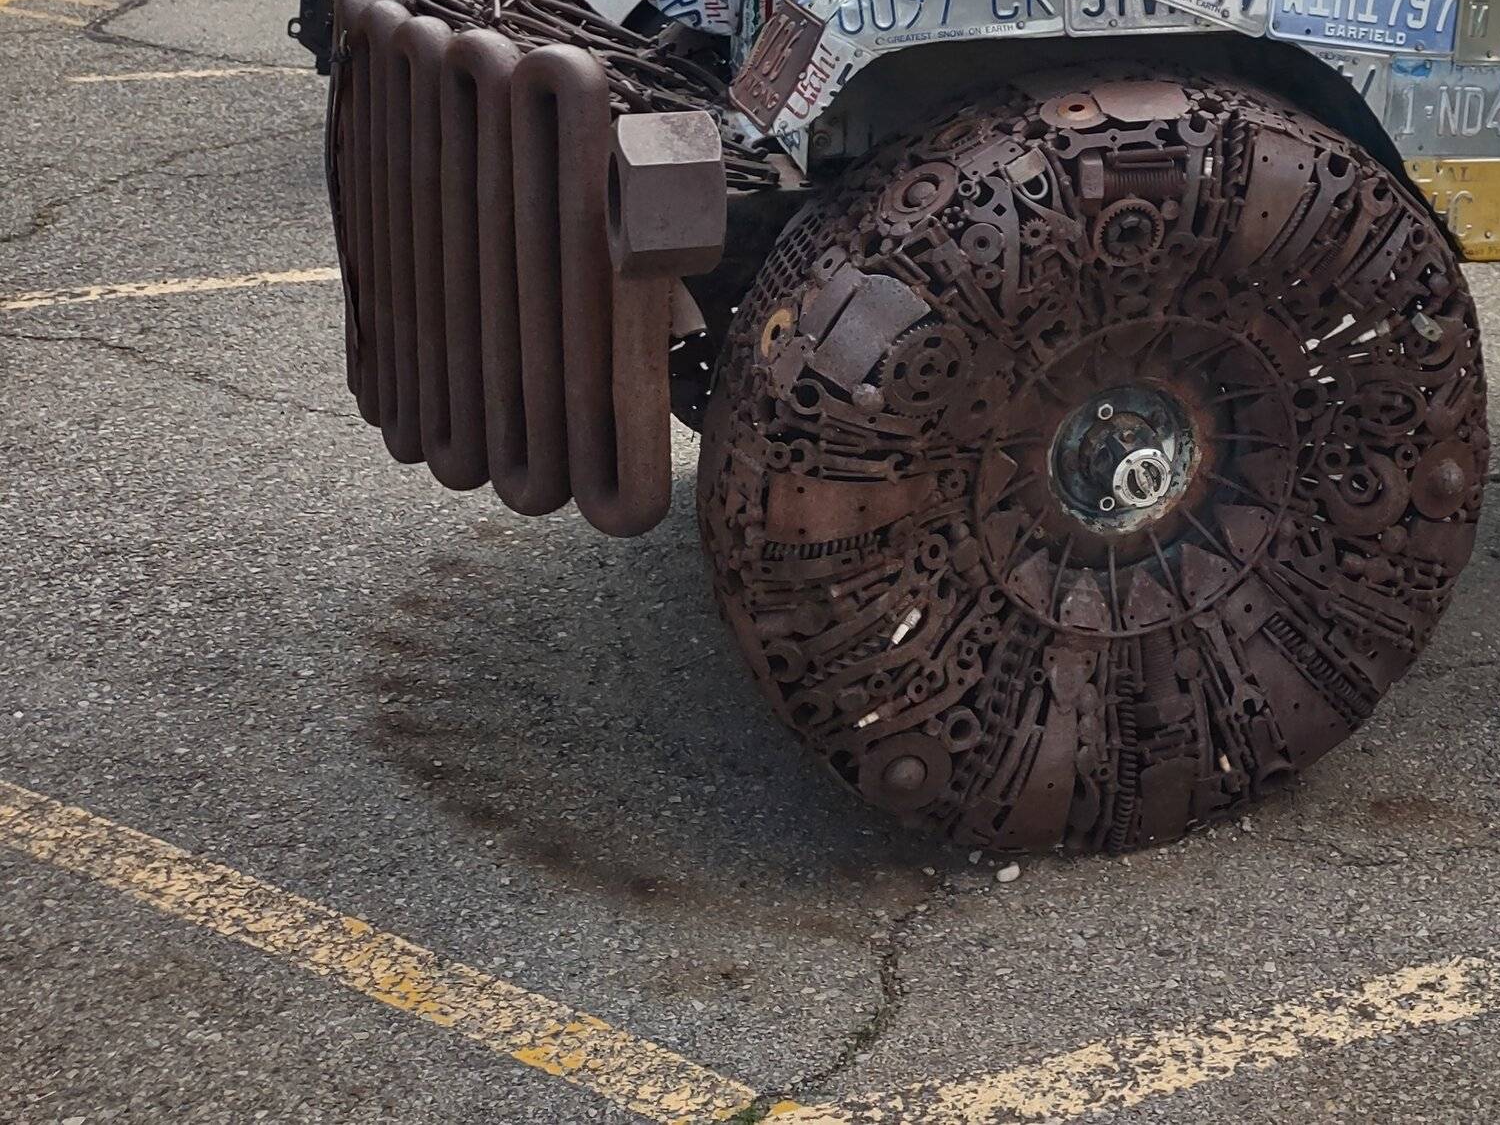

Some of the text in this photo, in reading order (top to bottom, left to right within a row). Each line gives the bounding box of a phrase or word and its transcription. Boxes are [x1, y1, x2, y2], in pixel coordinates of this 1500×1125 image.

[886, 24, 1014, 44] GREATEST SNOW ON EARTH
[1324, 22, 1407, 45] GARFIELD
